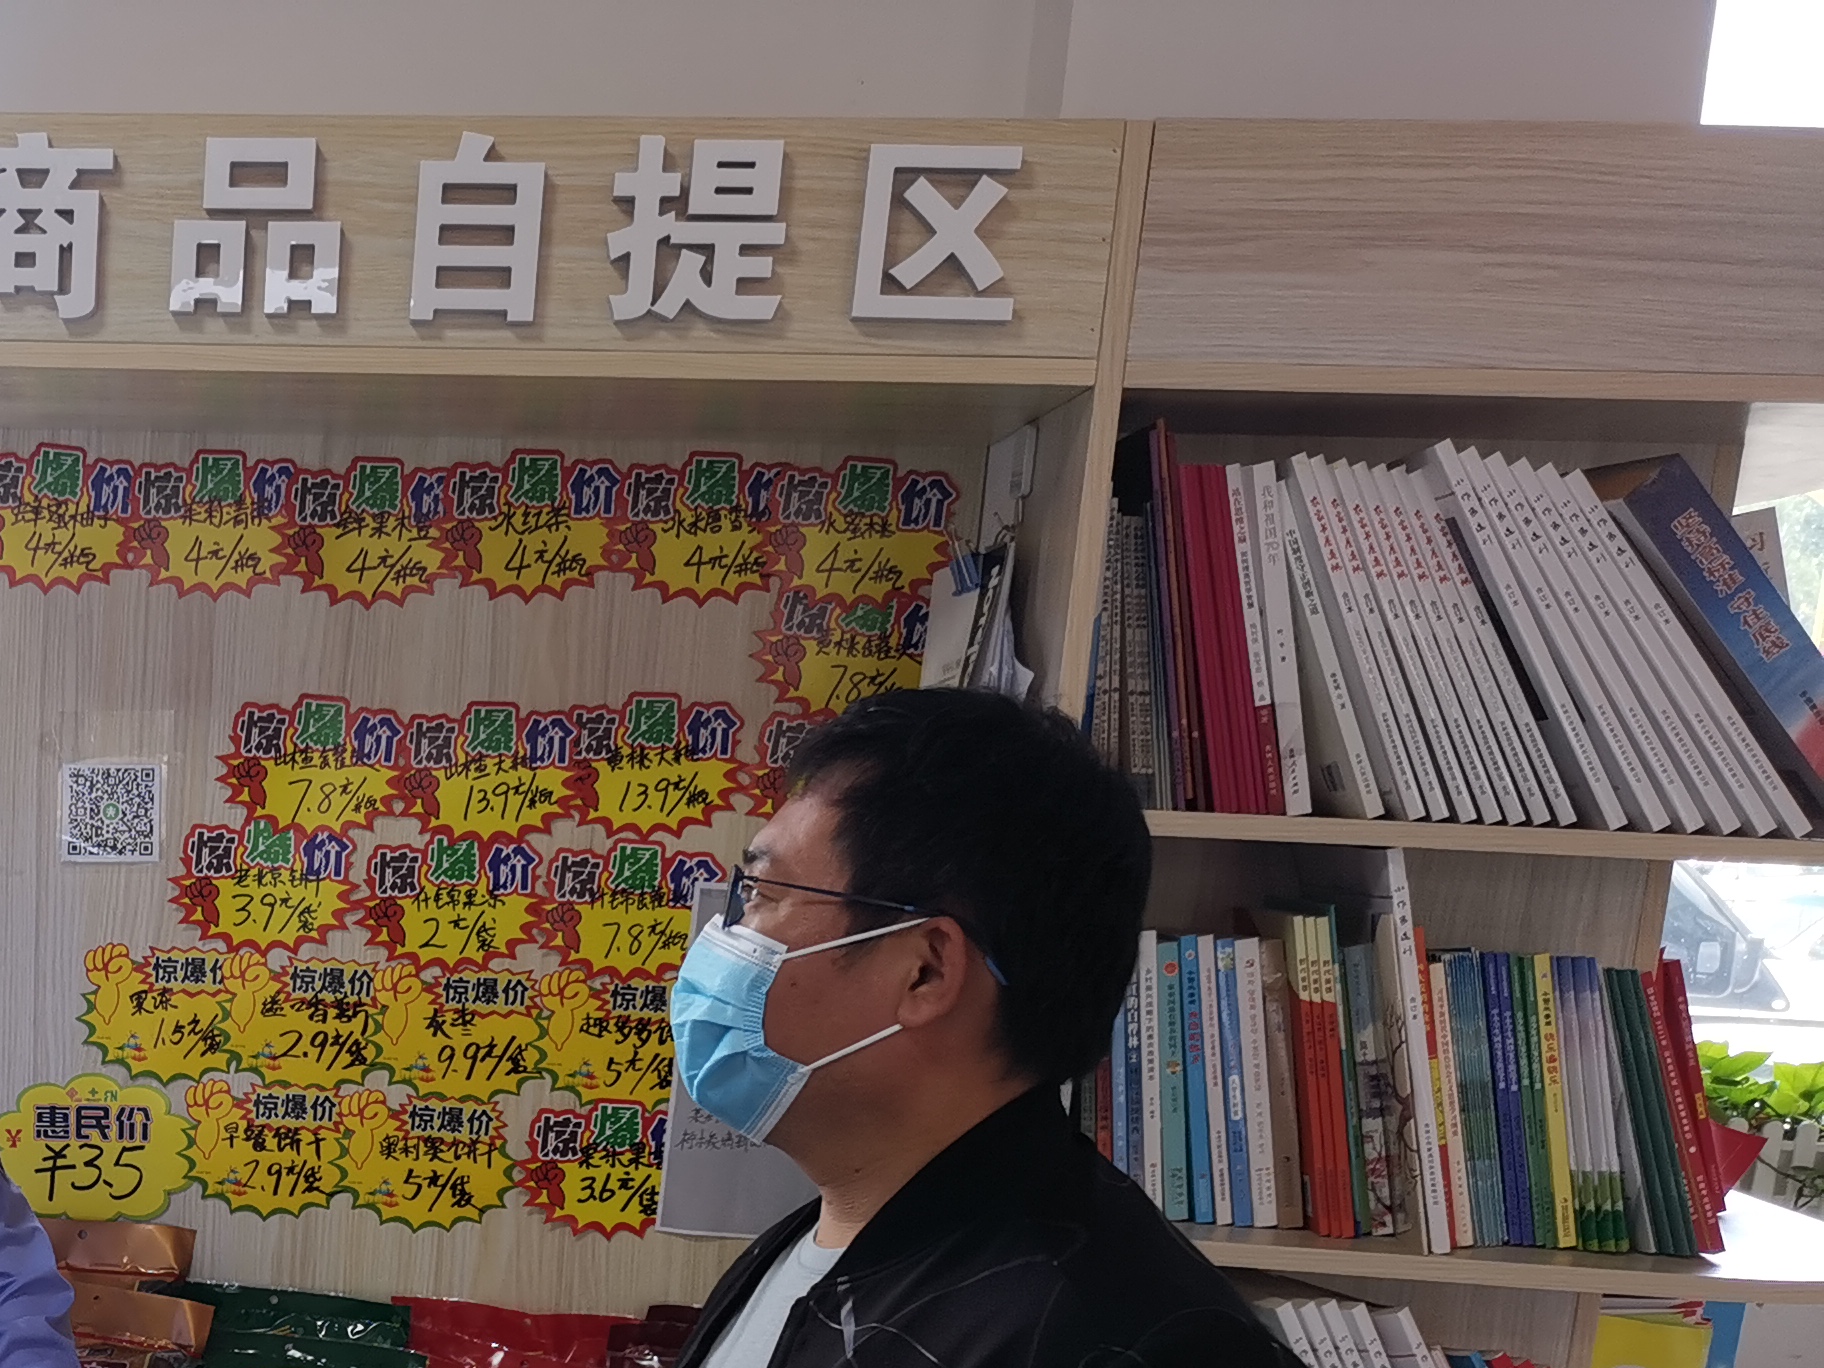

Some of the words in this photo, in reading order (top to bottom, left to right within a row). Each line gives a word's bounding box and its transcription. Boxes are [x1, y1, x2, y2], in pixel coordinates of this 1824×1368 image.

[137, 454, 295, 518] 惊爆价
[293, 463, 446, 525] 惊爆价
[449, 454, 620, 520] 惊爆价
[778, 463, 953, 532] 惊爆价
[826, 665, 903, 708] 7.8元/
[238, 699, 402, 765] 惊爆价
[405, 708, 576, 768] 惊爆价
[575, 698, 740, 761] 惊爆价
[190, 821, 350, 879] 惊爆价
[374, 837, 537, 898] 惊爆价
[553, 845, 723, 903] 惊爆价
[152, 956, 225, 986] 惊爆价
[290, 966, 375, 997] 惊爆价
[442, 977, 529, 1008] 惊爆价
[611, 983, 672, 1012] 惊爆
[33, 1105, 152, 1142] 惠民价
[253, 1094, 338, 1122] 惊爆价
[409, 1105, 494, 1136] 惊爆价
